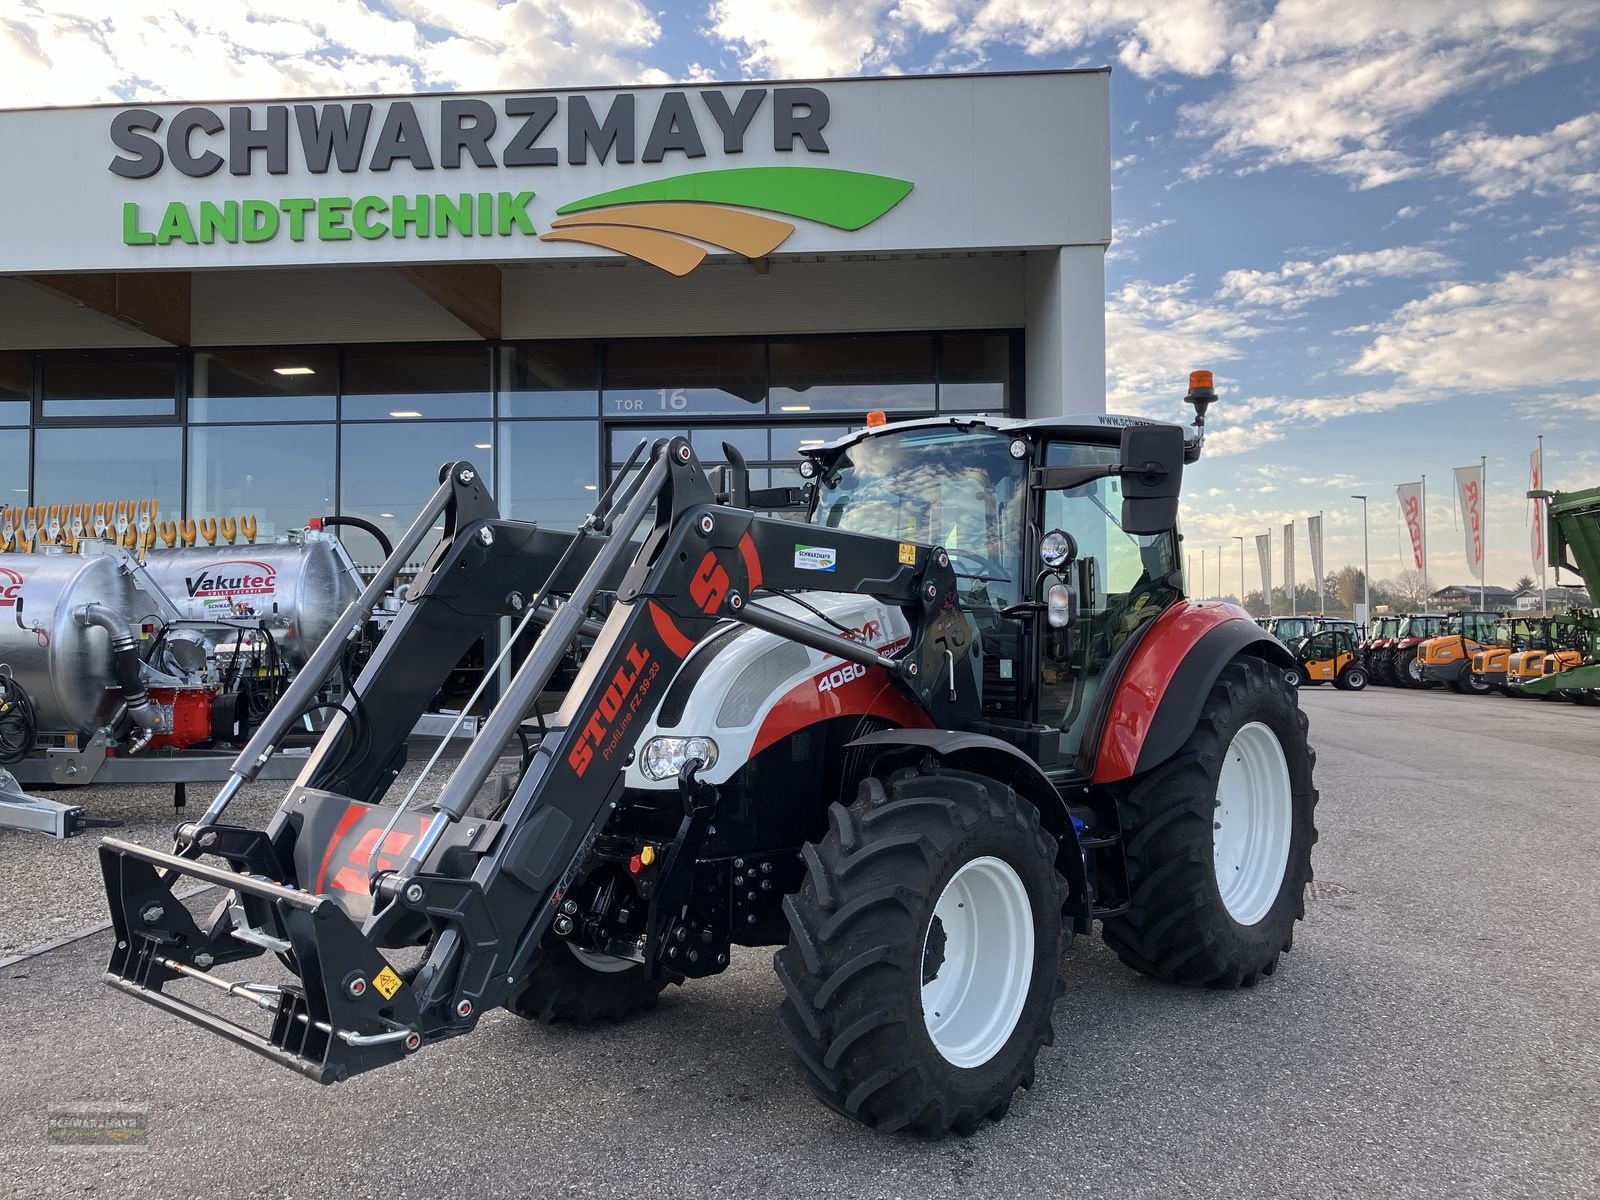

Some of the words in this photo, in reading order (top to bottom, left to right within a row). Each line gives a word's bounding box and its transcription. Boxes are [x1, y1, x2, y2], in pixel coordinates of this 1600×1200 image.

[107, 87, 830, 179] SCHWARZMAYR
[122, 191, 537, 246] LANDTECHNIK
[615, 400, 644, 410] TOR
[657, 388, 688, 410] 16
[185, 571, 276, 598] Vakutec
[818, 662, 866, 692] 4080
[568, 641, 650, 779] STOLL
[602, 712, 633, 760] ProfiLine
[629, 693, 642, 713] FZ
[639, 661, 661, 695] 39-23
